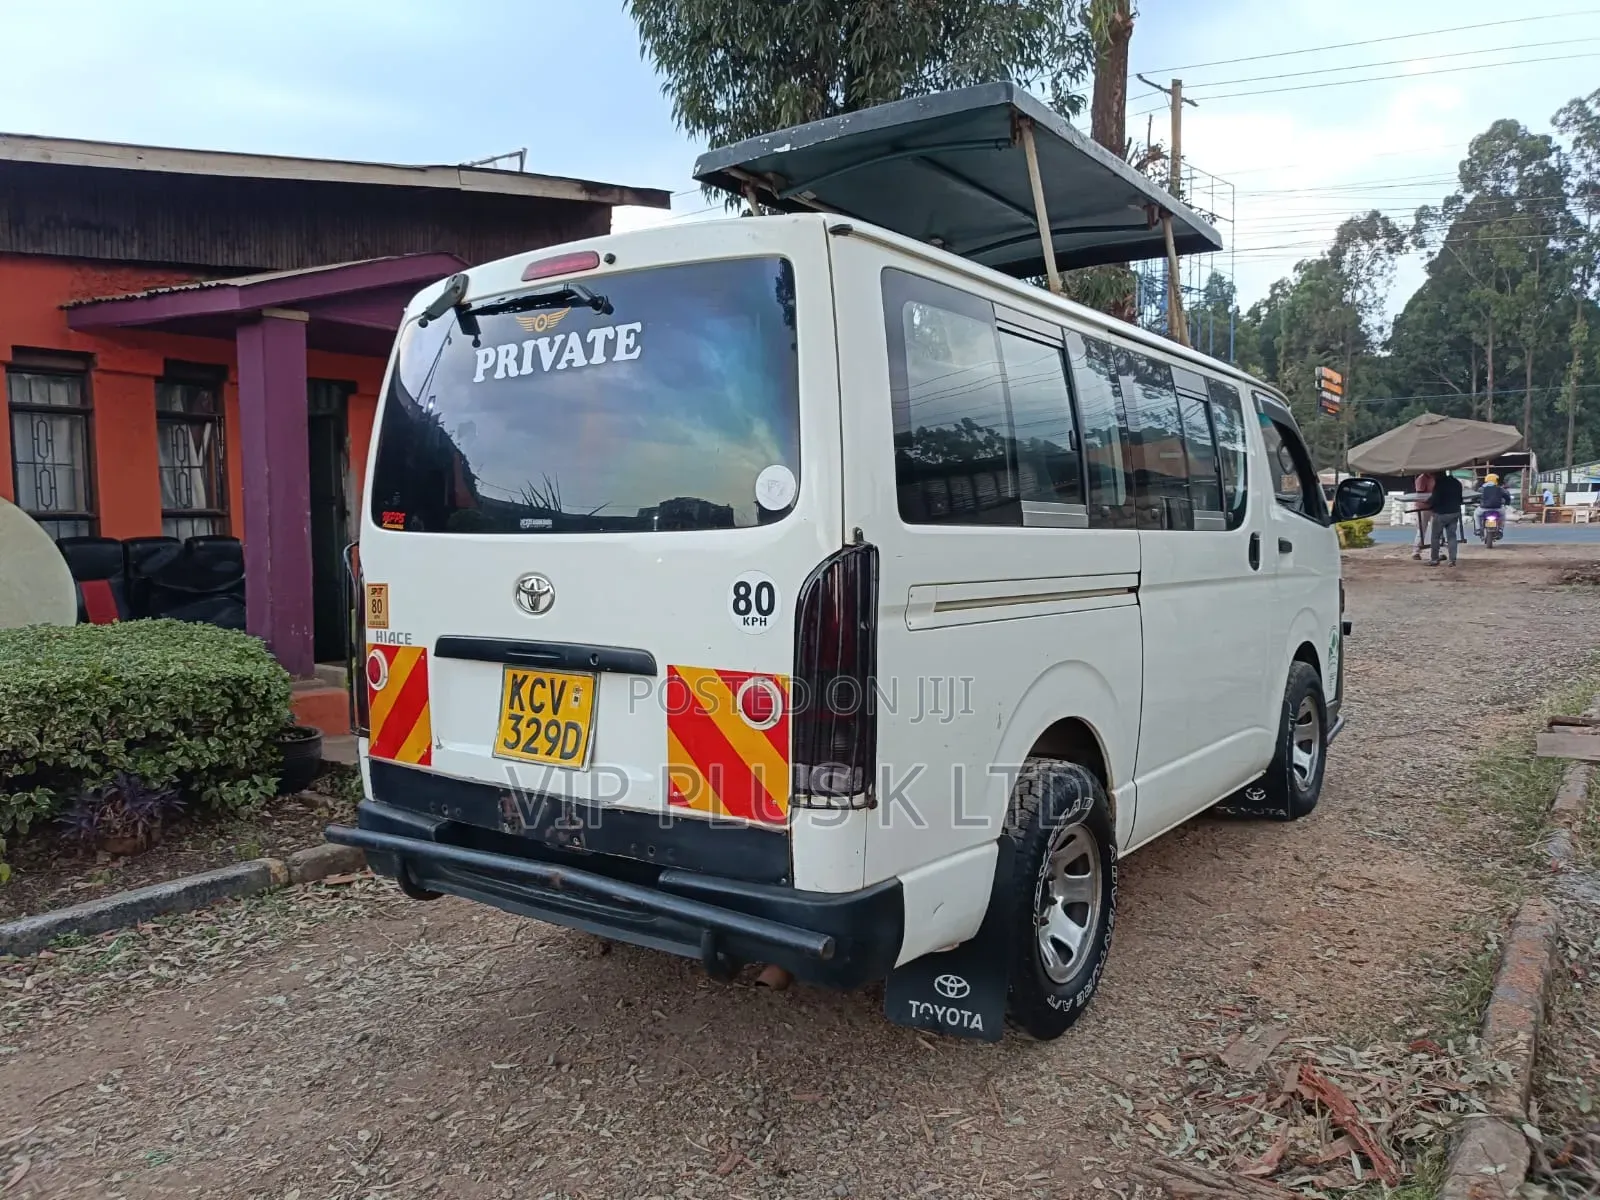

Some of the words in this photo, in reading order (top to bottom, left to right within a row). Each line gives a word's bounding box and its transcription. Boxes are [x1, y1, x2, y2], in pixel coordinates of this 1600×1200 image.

[472, 321, 642, 383] PRIVATE
[371, 598, 383, 614] 80
[732, 580, 776, 617] 80
[375, 630, 413, 645] HIACE
[742, 616, 768, 627] KPH
[508, 673, 568, 716] KCV
[503, 713, 582, 760] 329D
[908, 1000, 984, 1032] TOYOTA
